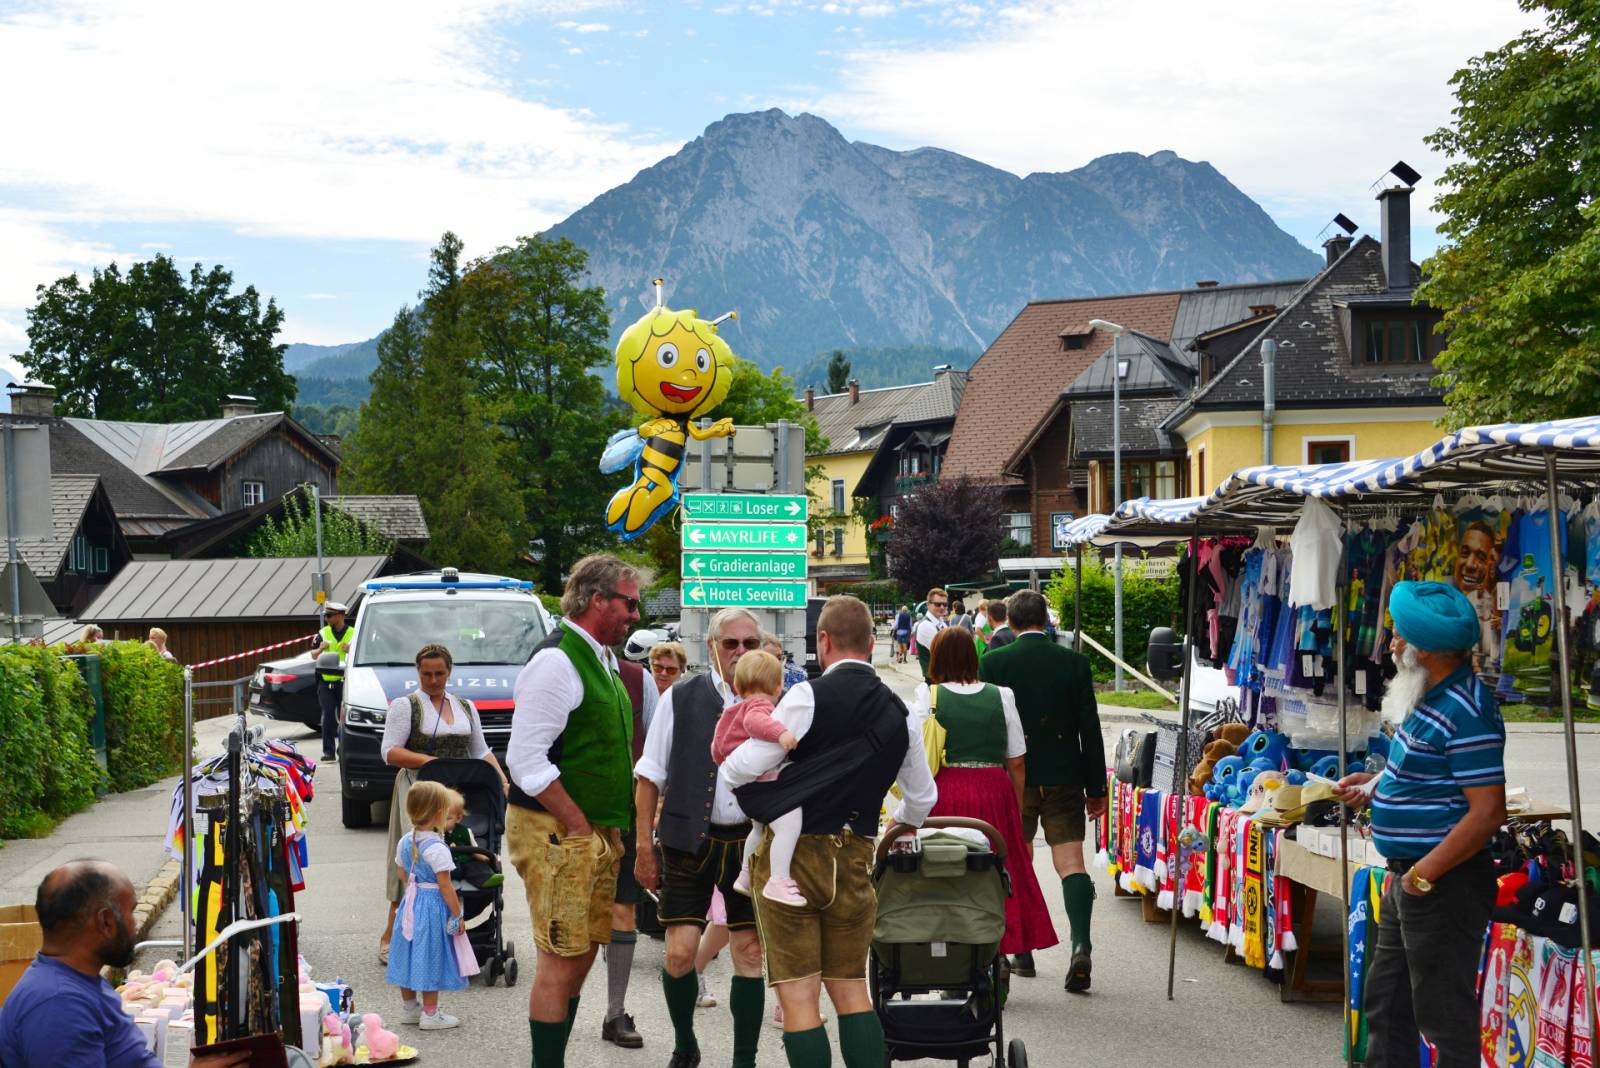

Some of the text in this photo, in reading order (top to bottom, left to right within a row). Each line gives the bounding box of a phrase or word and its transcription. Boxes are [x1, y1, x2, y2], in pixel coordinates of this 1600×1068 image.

[746, 501, 779, 515] Loser
[709, 530, 780, 544] MAYRLIFE
[709, 558, 795, 575] Gradieranlage
[709, 587, 794, 601] Hotel Seevilla
[405, 678, 509, 689] PIZEI
